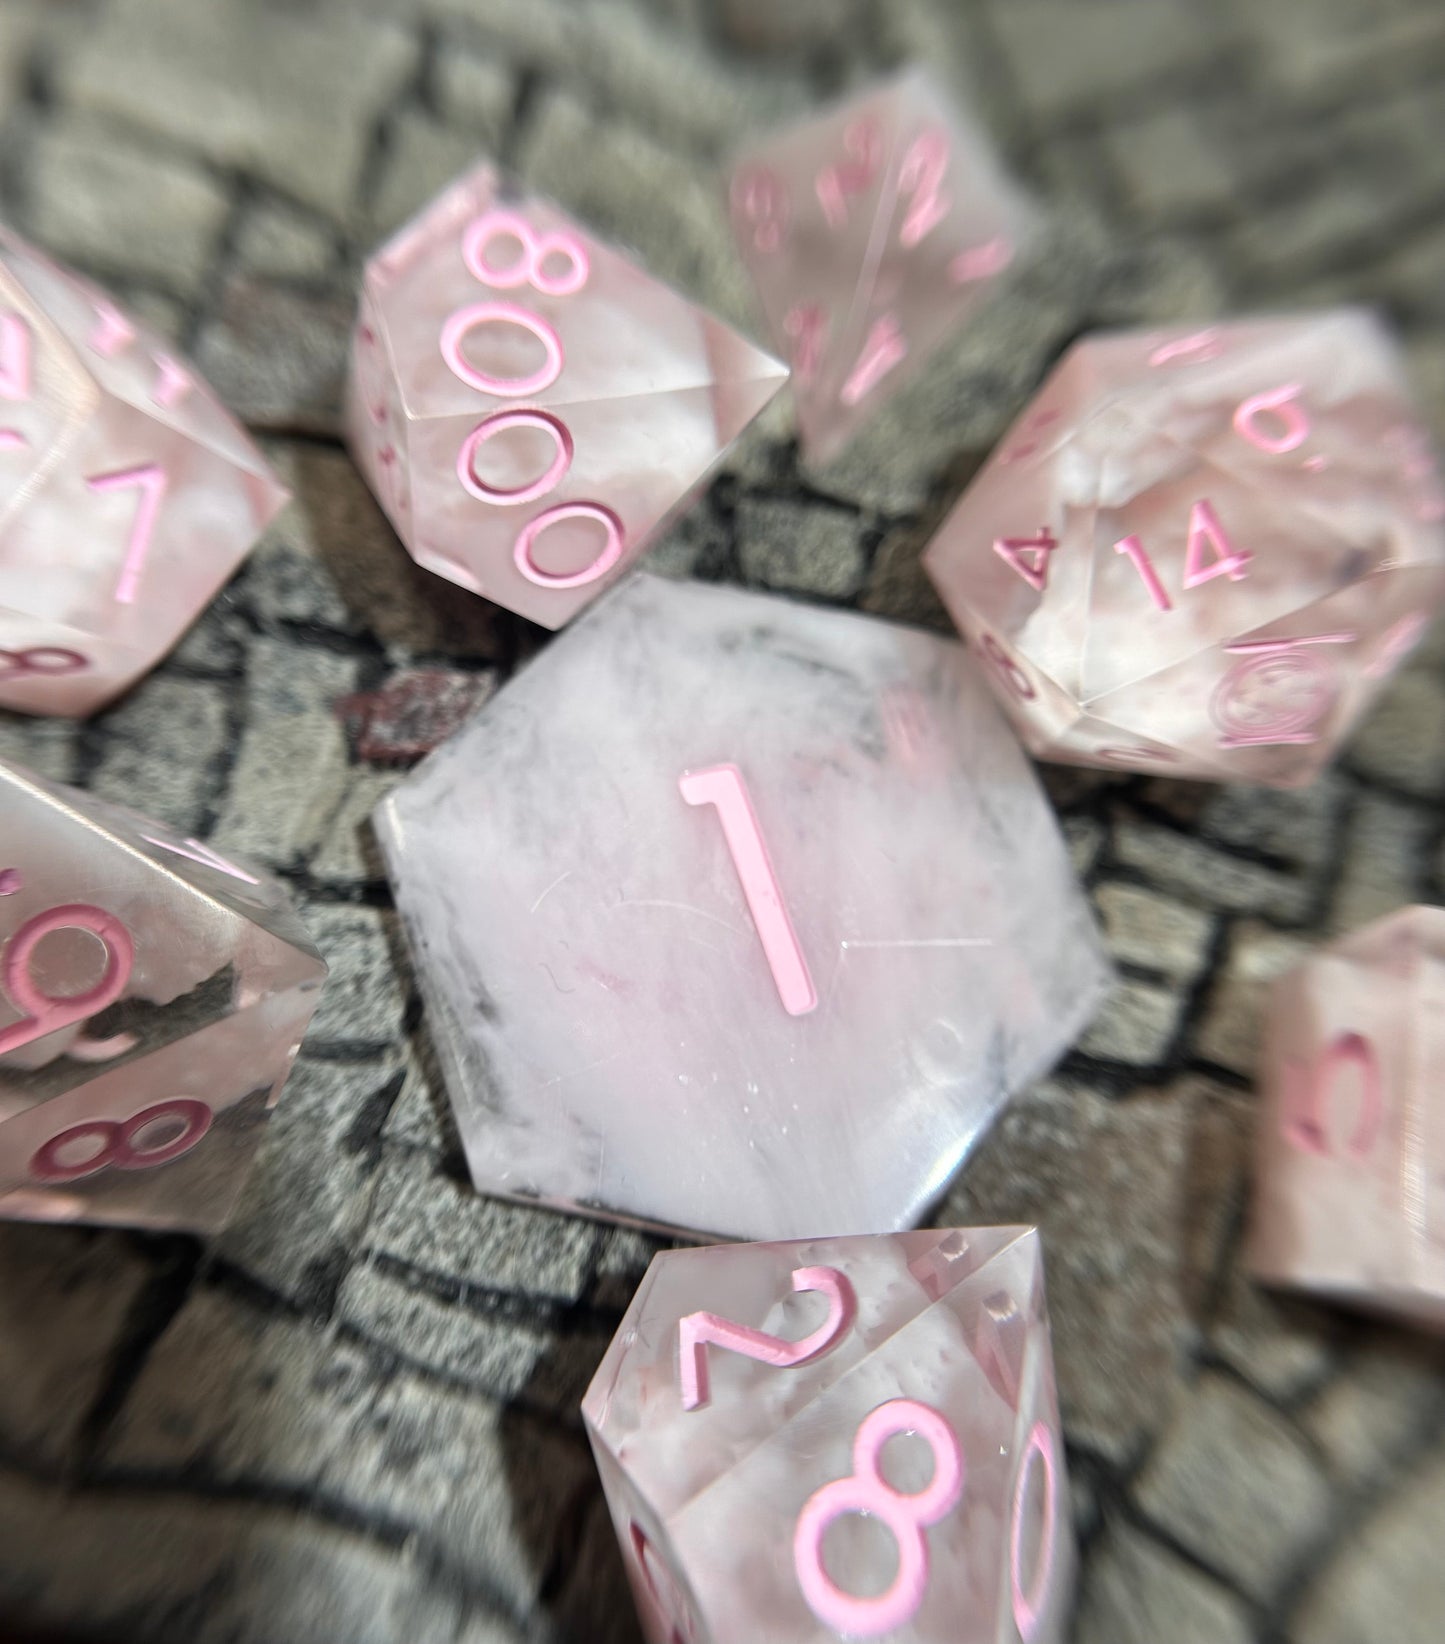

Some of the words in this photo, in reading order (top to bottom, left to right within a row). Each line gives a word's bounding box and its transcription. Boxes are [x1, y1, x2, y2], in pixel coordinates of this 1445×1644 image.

[87, 464, 166, 604] 7
[993, 526, 1059, 592] 4
[1113, 498, 1255, 611] 14
[678, 762, 819, 1017] 1
[29, 1098, 215, 1184] 8
[679, 1264, 859, 1412] 2
[793, 1397, 964, 1636] 8
